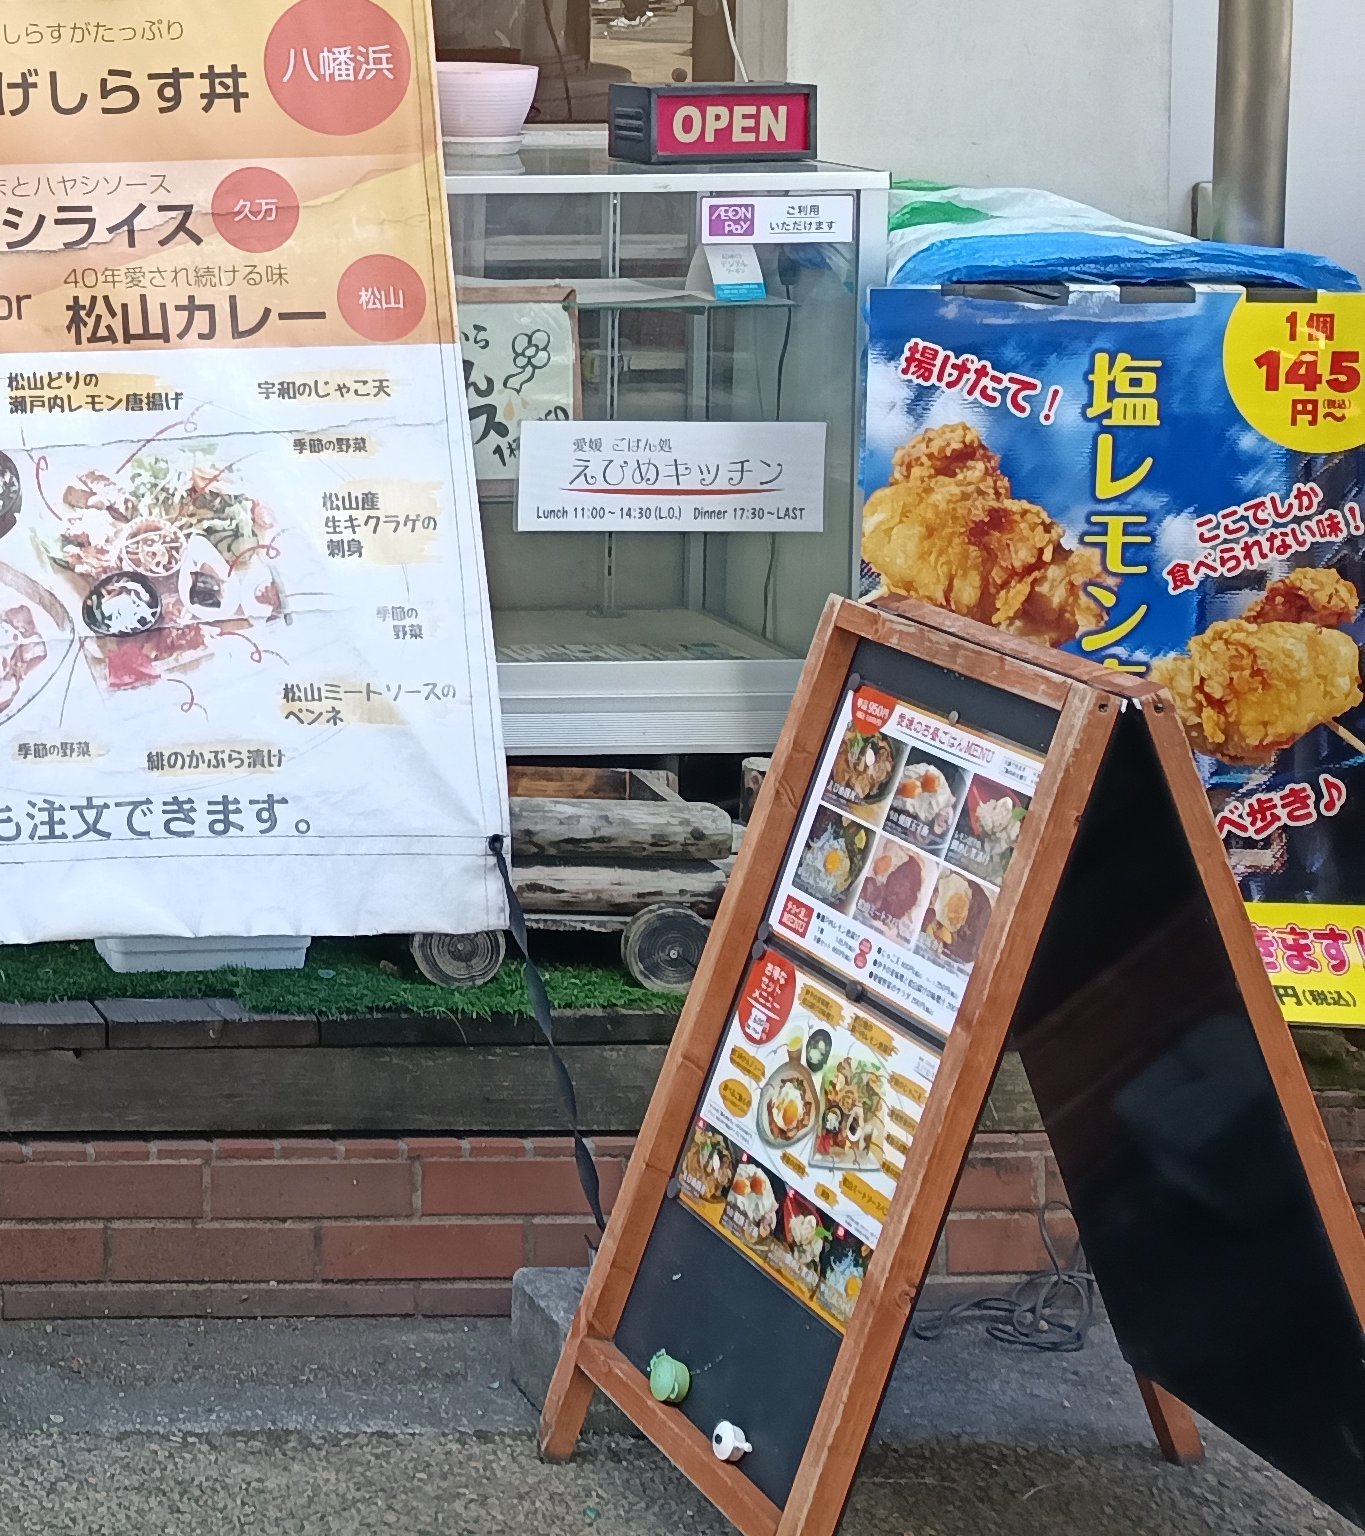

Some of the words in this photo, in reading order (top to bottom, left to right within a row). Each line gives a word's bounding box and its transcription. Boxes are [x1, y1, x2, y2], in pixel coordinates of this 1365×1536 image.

[282, 45, 395, 84] 八幡浜
[672, 104, 788, 144] OPEN
[785, 204, 821, 218] ご利用
[769, 219, 837, 233] いただけます
[62, 264, 290, 291] 40年愛され続ける味
[357, 285, 405, 312] 松山
[64, 292, 328, 347] 松山カレー
[1285, 311, 1336, 344] 1個
[7, 371, 99, 392] 松山どりの
[900, 338, 1064, 425] 揚げたて！
[1253, 349, 1362, 395] 145
[257, 377, 391, 400] 宇和のじゃこ天
[8, 391, 184, 414] 瀬戸内レモン唐揚げ
[292, 436, 369, 455] 季節の野菜
[573, 437, 604, 454] 愛媛
[611, 436, 674, 454] ごはん処
[569, 457, 784, 487] えひめキッチン
[322, 490, 381, 511] 松山産
[1081, 351, 1163, 673] 塩レモン
[536, 505, 569, 521] Lunch
[693, 505, 728, 521] Dinner
[1196, 482, 1321, 547] ここでしか
[324, 514, 438, 536] 生キクラゲの
[326, 537, 365, 560] 刺身
[1166, 507, 1365, 592] 食べられない味！
[375, 605, 419, 623] 季節の
[392, 624, 425, 641] 野菜
[282, 682, 457, 704] 松山ミートソースの
[284, 706, 345, 727] ペンネ
[17, 741, 93, 760] 季節の野菜
[146, 748, 287, 772] 緋のかぶら漬け
